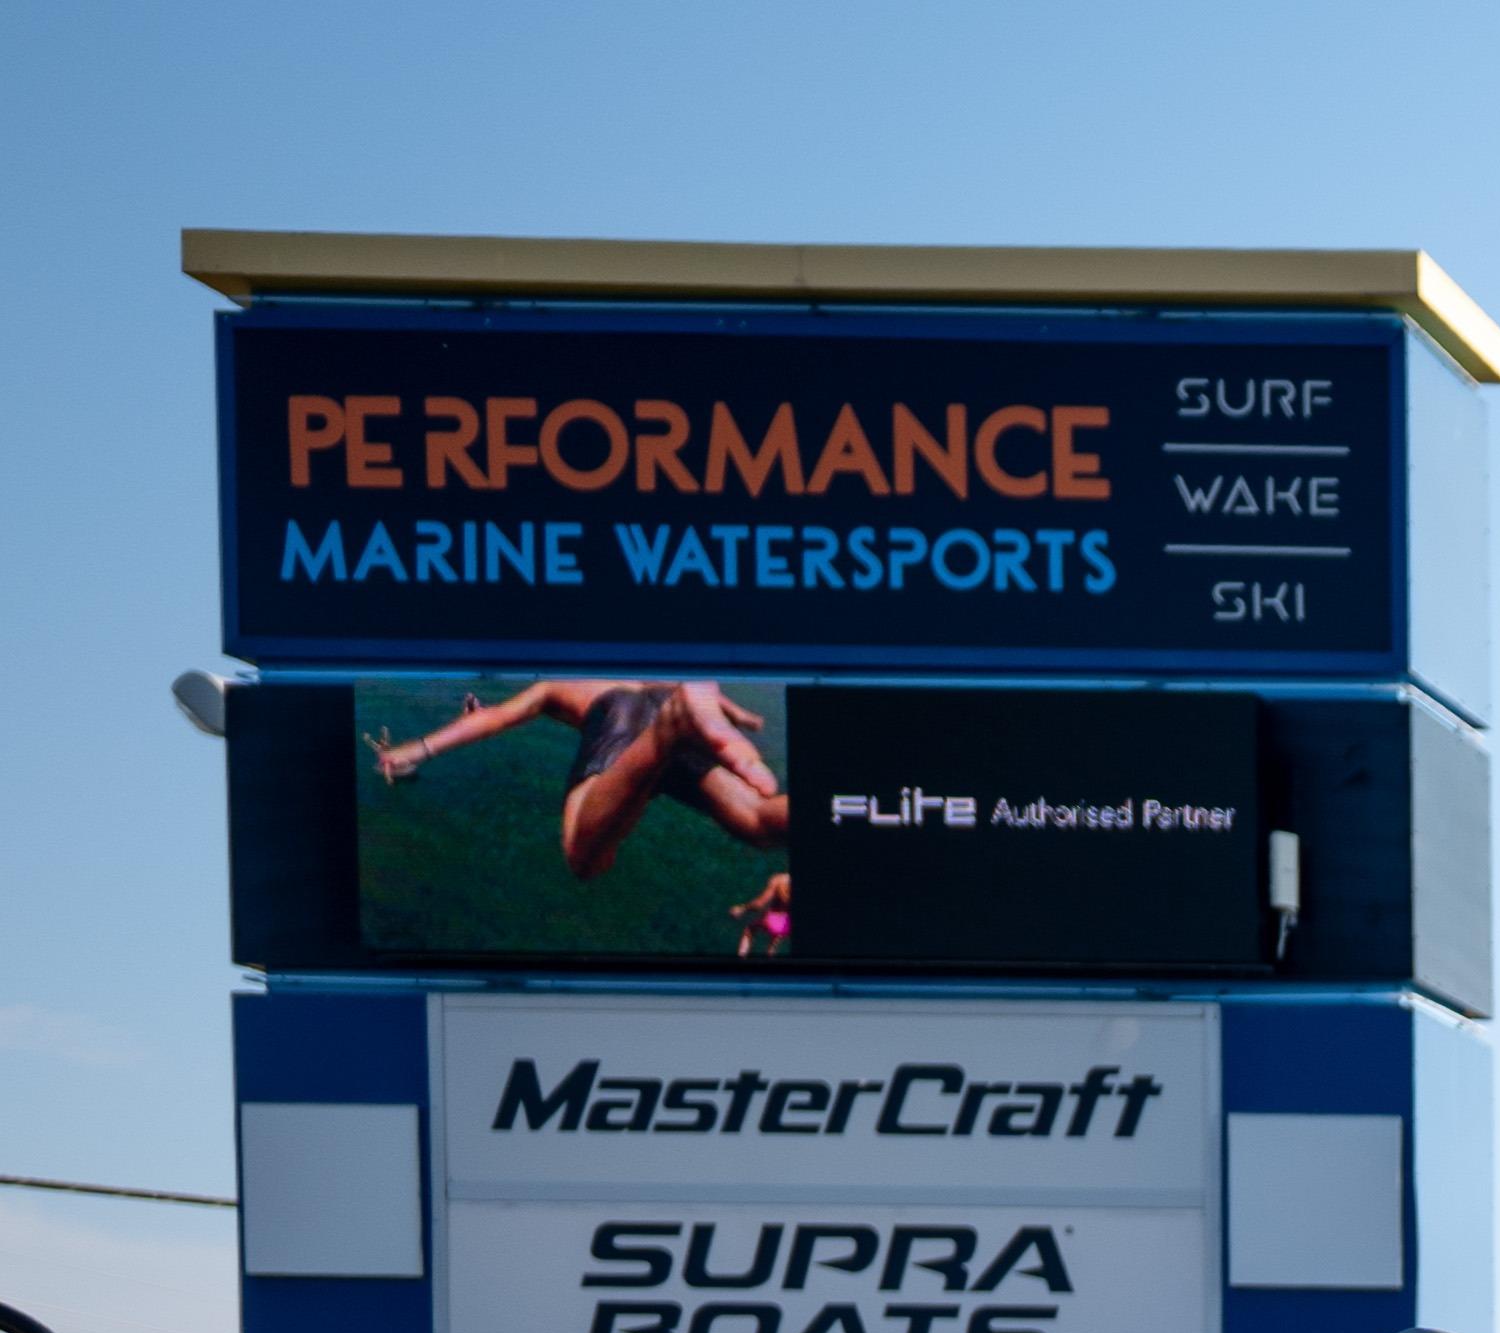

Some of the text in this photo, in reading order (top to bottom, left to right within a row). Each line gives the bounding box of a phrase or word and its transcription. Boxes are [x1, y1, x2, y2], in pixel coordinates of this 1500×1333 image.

[1175, 377, 1336, 419] SURF
[286, 395, 1112, 499] PERFORMANCE
[1173, 475, 1340, 518] WAKE
[280, 518, 1118, 595] MARINE WATERSPORTS
[1211, 579, 1307, 622] SKI
[990, 795, 1134, 830] Authorised
[1141, 798, 1237, 831] Partner
[491, 1057, 1164, 1139] MasterCraft
[580, 1221, 1075, 1294] SUPRA
